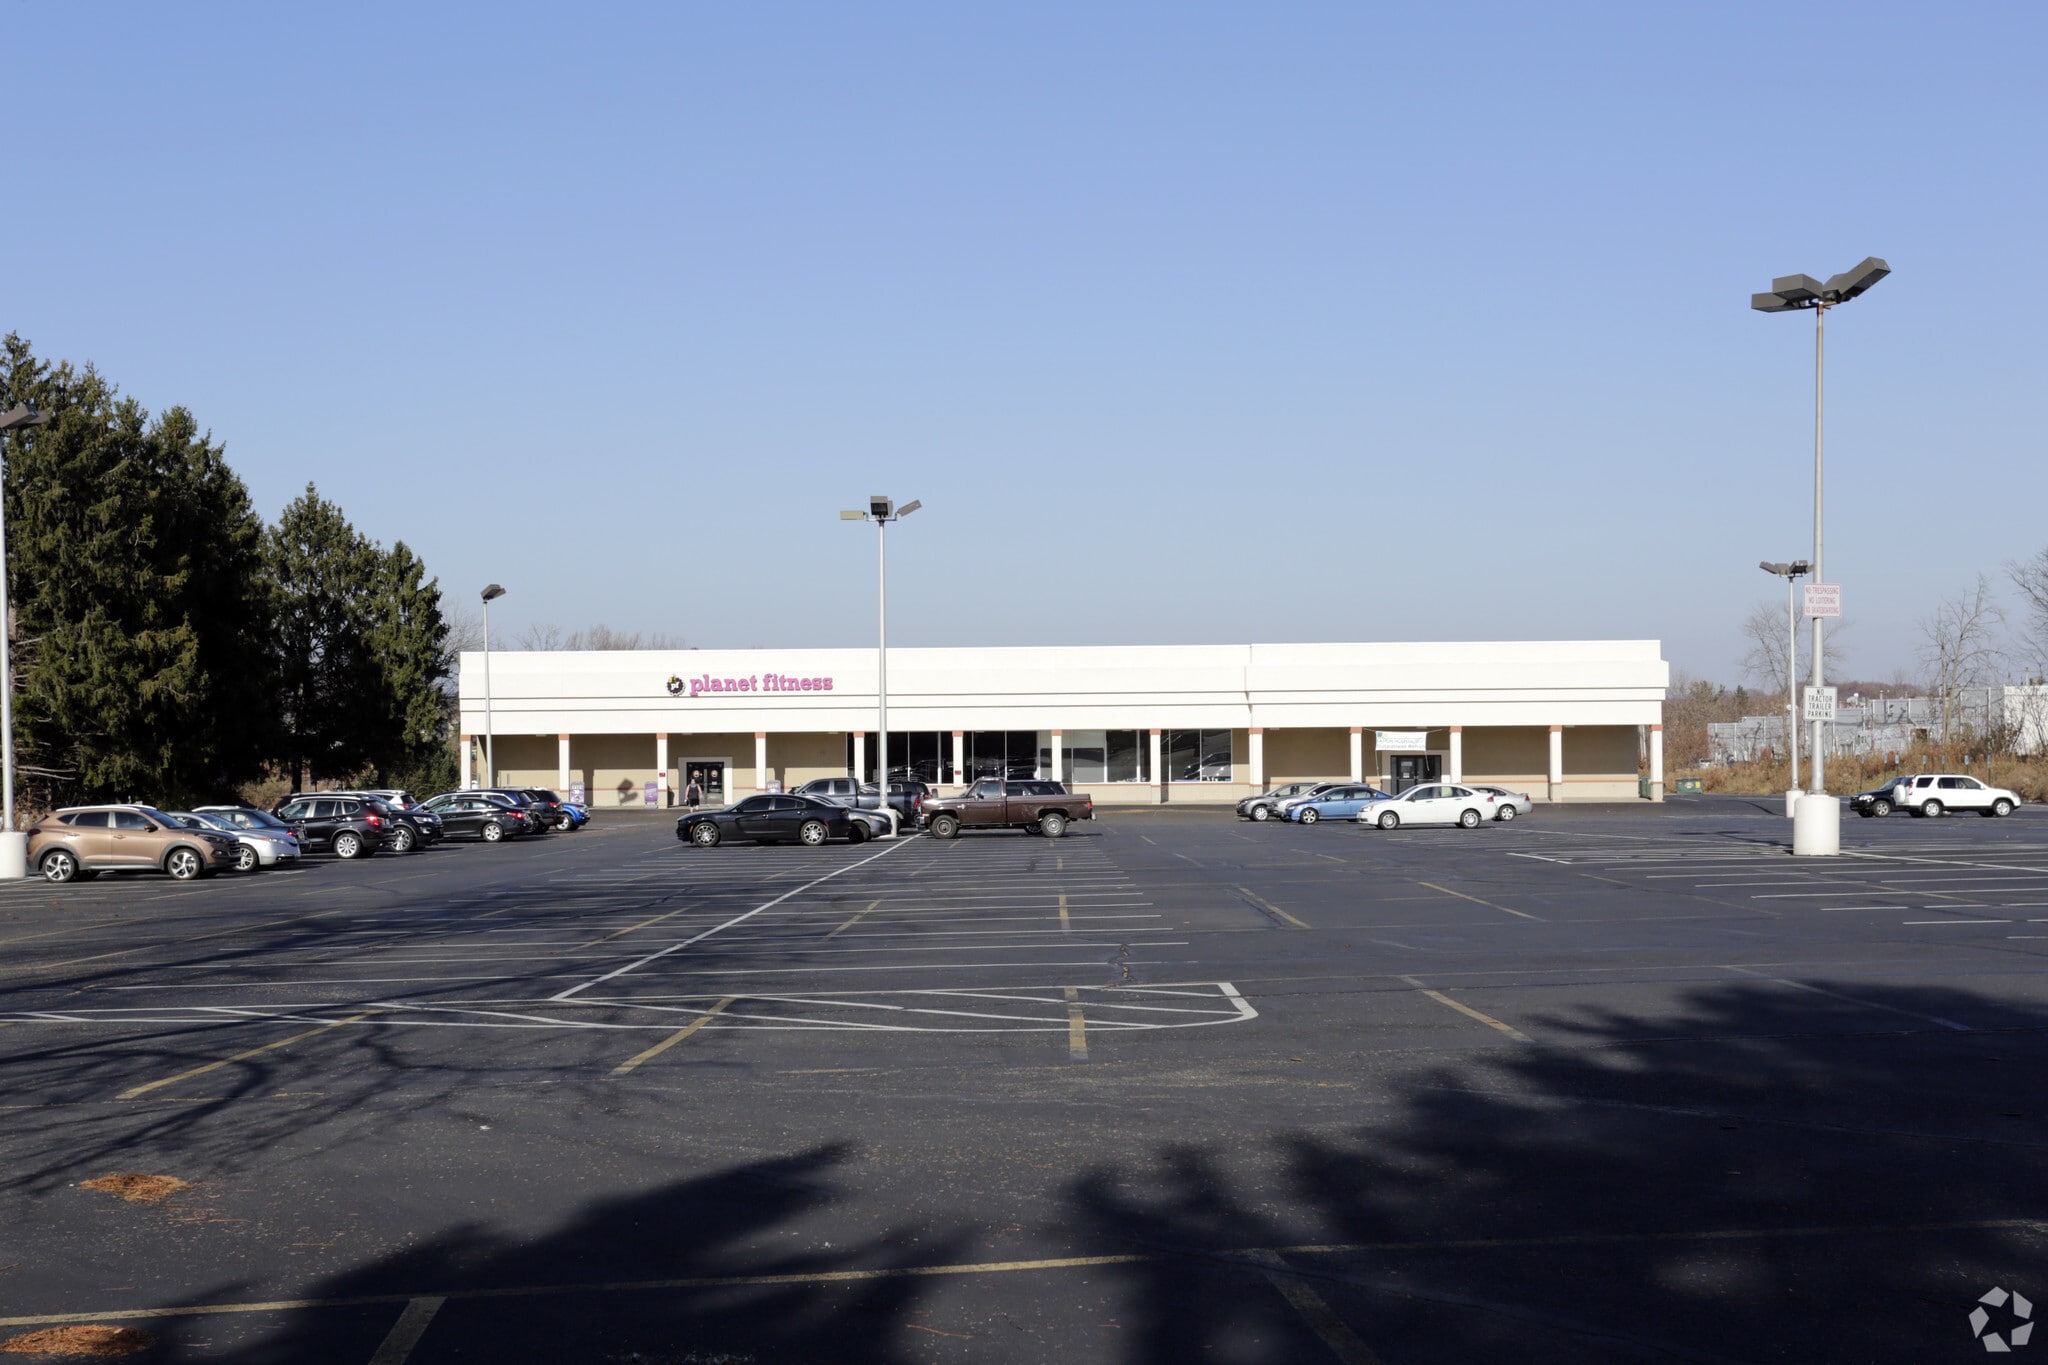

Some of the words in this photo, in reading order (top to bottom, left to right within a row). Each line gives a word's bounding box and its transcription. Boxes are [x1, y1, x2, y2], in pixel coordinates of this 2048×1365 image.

[690, 674, 758, 697] planet
[763, 673, 833, 692] fitness
[1816, 688, 1825, 696] NO
[1808, 695, 1833, 703] TRACTOR
[1808, 702, 1832, 710] TRAILER
[1807, 710, 1833, 719] PARKING
